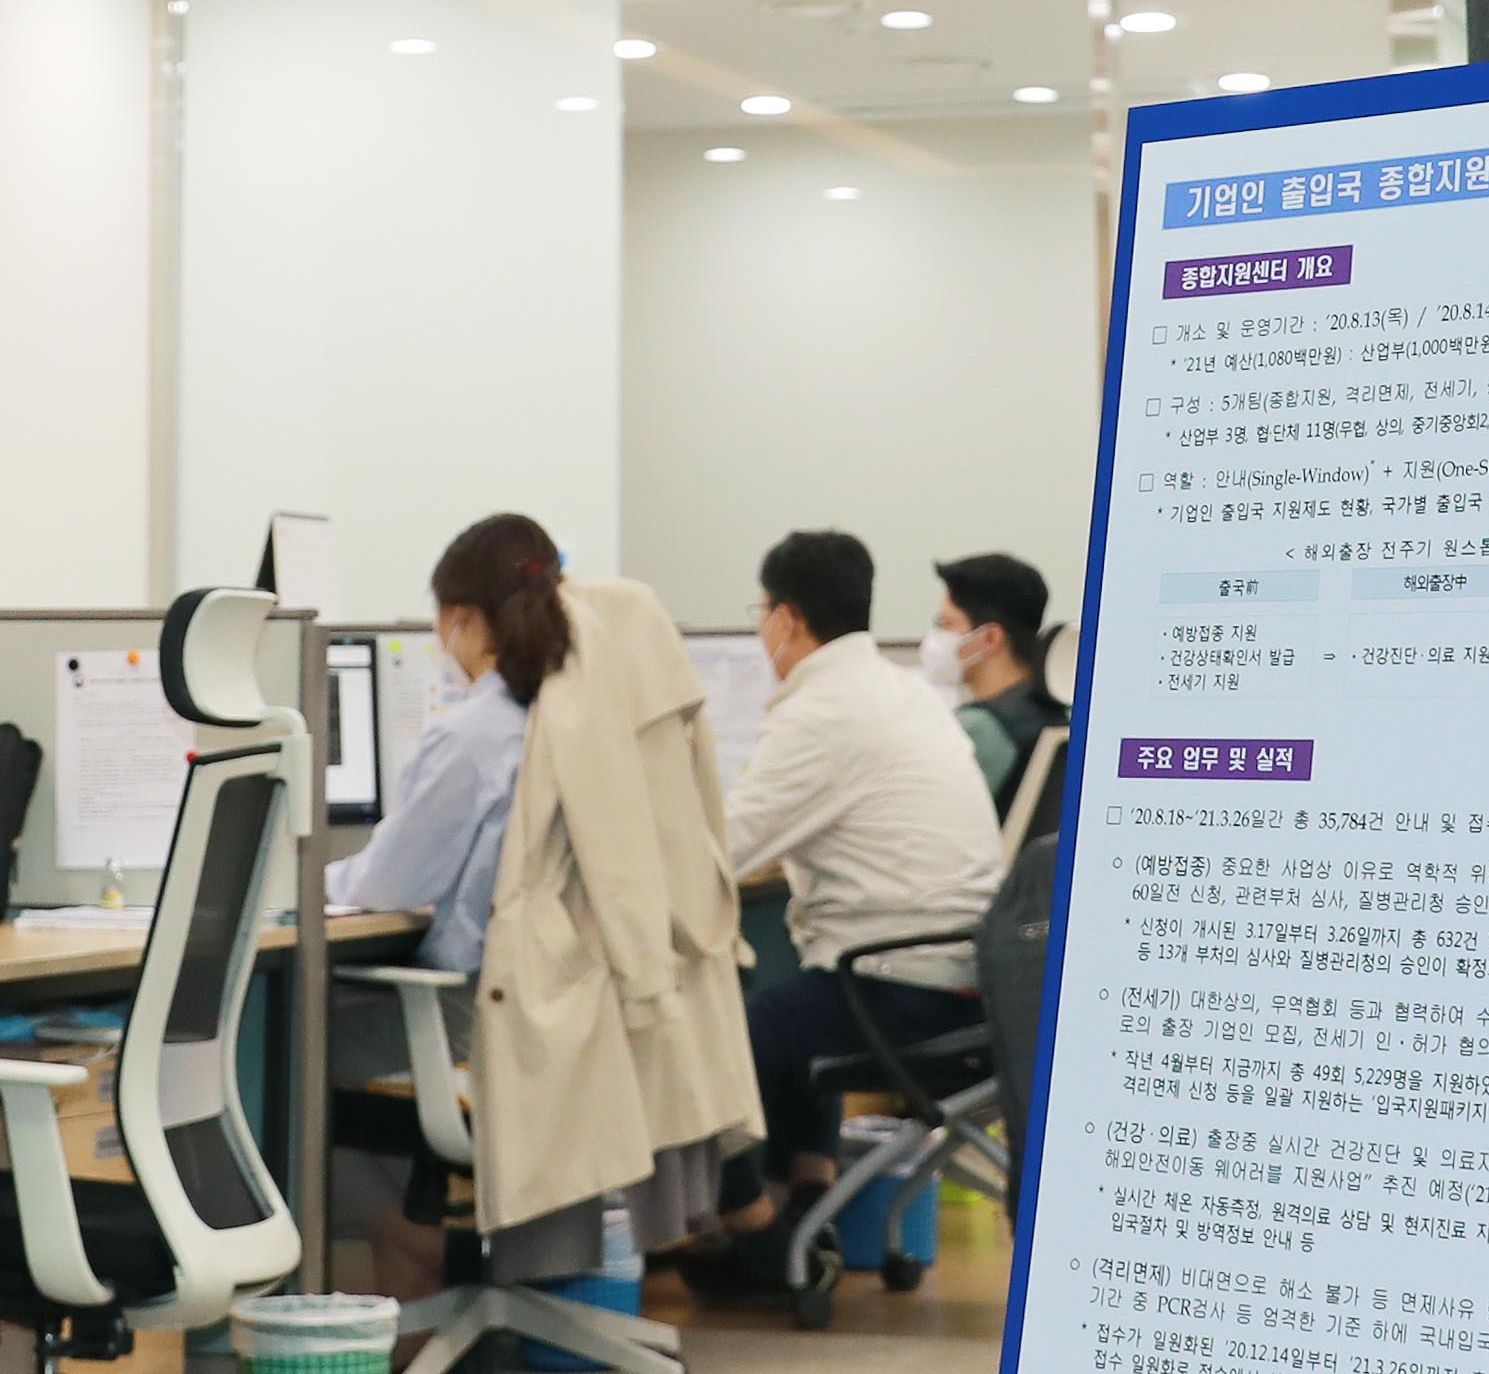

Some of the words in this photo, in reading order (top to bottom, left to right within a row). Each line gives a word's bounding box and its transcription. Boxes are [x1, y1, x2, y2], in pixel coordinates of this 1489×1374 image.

[1187, 180, 1265, 219] 기업인
[1281, 170, 1362, 210] 출입국
[1181, 258, 1288, 291] 종합지원센터
[1297, 255, 1333, 280] 개요
[1175, 323, 1207, 343] 개소
[1216, 321, 1232, 341] 및
[1239, 315, 1305, 339] 운영기간
[1169, 395, 1201, 415] 구성
[1179, 427, 1220, 448] 산업부
[1163, 471, 1195, 491] 역할
[1170, 503, 1214, 524] 기업인
[1220, 501, 1265, 523] 출입국
[1271, 498, 1332, 520] 지원제도
[1379, 493, 1428, 516] 국가별
[1433, 492, 1486, 514] 출입국
[1303, 541, 1375, 562] 해외출장
[1380, 539, 1432, 560] 전주기
[1171, 624, 1227, 646] 예방접종
[1228, 623, 1257, 645] 지원
[1169, 646, 1262, 670] 건강상태확인서
[1268, 647, 1296, 667] 발급
[1167, 670, 1207, 691] 전세기
[1212, 670, 1240, 691] 지원
[1137, 746, 1173, 770] 주요
[1183, 746, 1219, 771] 업무
[1228, 747, 1247, 771] 및
[1256, 747, 1293, 772] 실적
[1293, 809, 1312, 831] 총
[1395, 812, 1433, 833] 안내
[1437, 812, 1459, 834] 및
[1221, 856, 1271, 878] 중요한
[1280, 858, 1332, 882] 사업상
[1343, 860, 1395, 882] 이유로
[1406, 862, 1461, 885] 역학적
[1131, 881, 1184, 903] 60일전
[1232, 884, 1305, 909] 관련부처
[1358, 889, 1447, 914] 질병관리청
[1270, 995, 1338, 1020] 무역협회
[1347, 999, 1384, 1024] 등과
[1394, 1001, 1464, 1028] 협력하여
[1119, 1013, 1152, 1036] 로의
[1161, 1015, 1194, 1039] 출장
[1203, 1019, 1254, 1043] 기업인
[1312, 1025, 1368, 1051] 전세기
[1207, 1128, 1259, 1154] 출장중
[1267, 1134, 1321, 1158] 실시간
[1329, 1138, 1402, 1165] 건강진단
[1410, 1145, 1428, 1170] 및
[1104, 1147, 1207, 1178] 해외안전이동
[1212, 1157, 1283, 1185] 웨어러블
[1382, 1173, 1421, 1198] 추진
[1111, 1211, 1172, 1238] 입국절차
[1173, 1216, 1193, 1240] 및
[1193, 1218, 1260, 1245] 방역정보
[1260, 1225, 1296, 1251] 안내
[1299, 1230, 1316, 1254] 등
[1178, 1267, 1267, 1296] 비대면으로
[1278, 1278, 1313, 1303] 해소
[1325, 1283, 1361, 1307] 불가
[1371, 1288, 1391, 1311] 등
[1401, 1292, 1475, 1322] 면제사유
